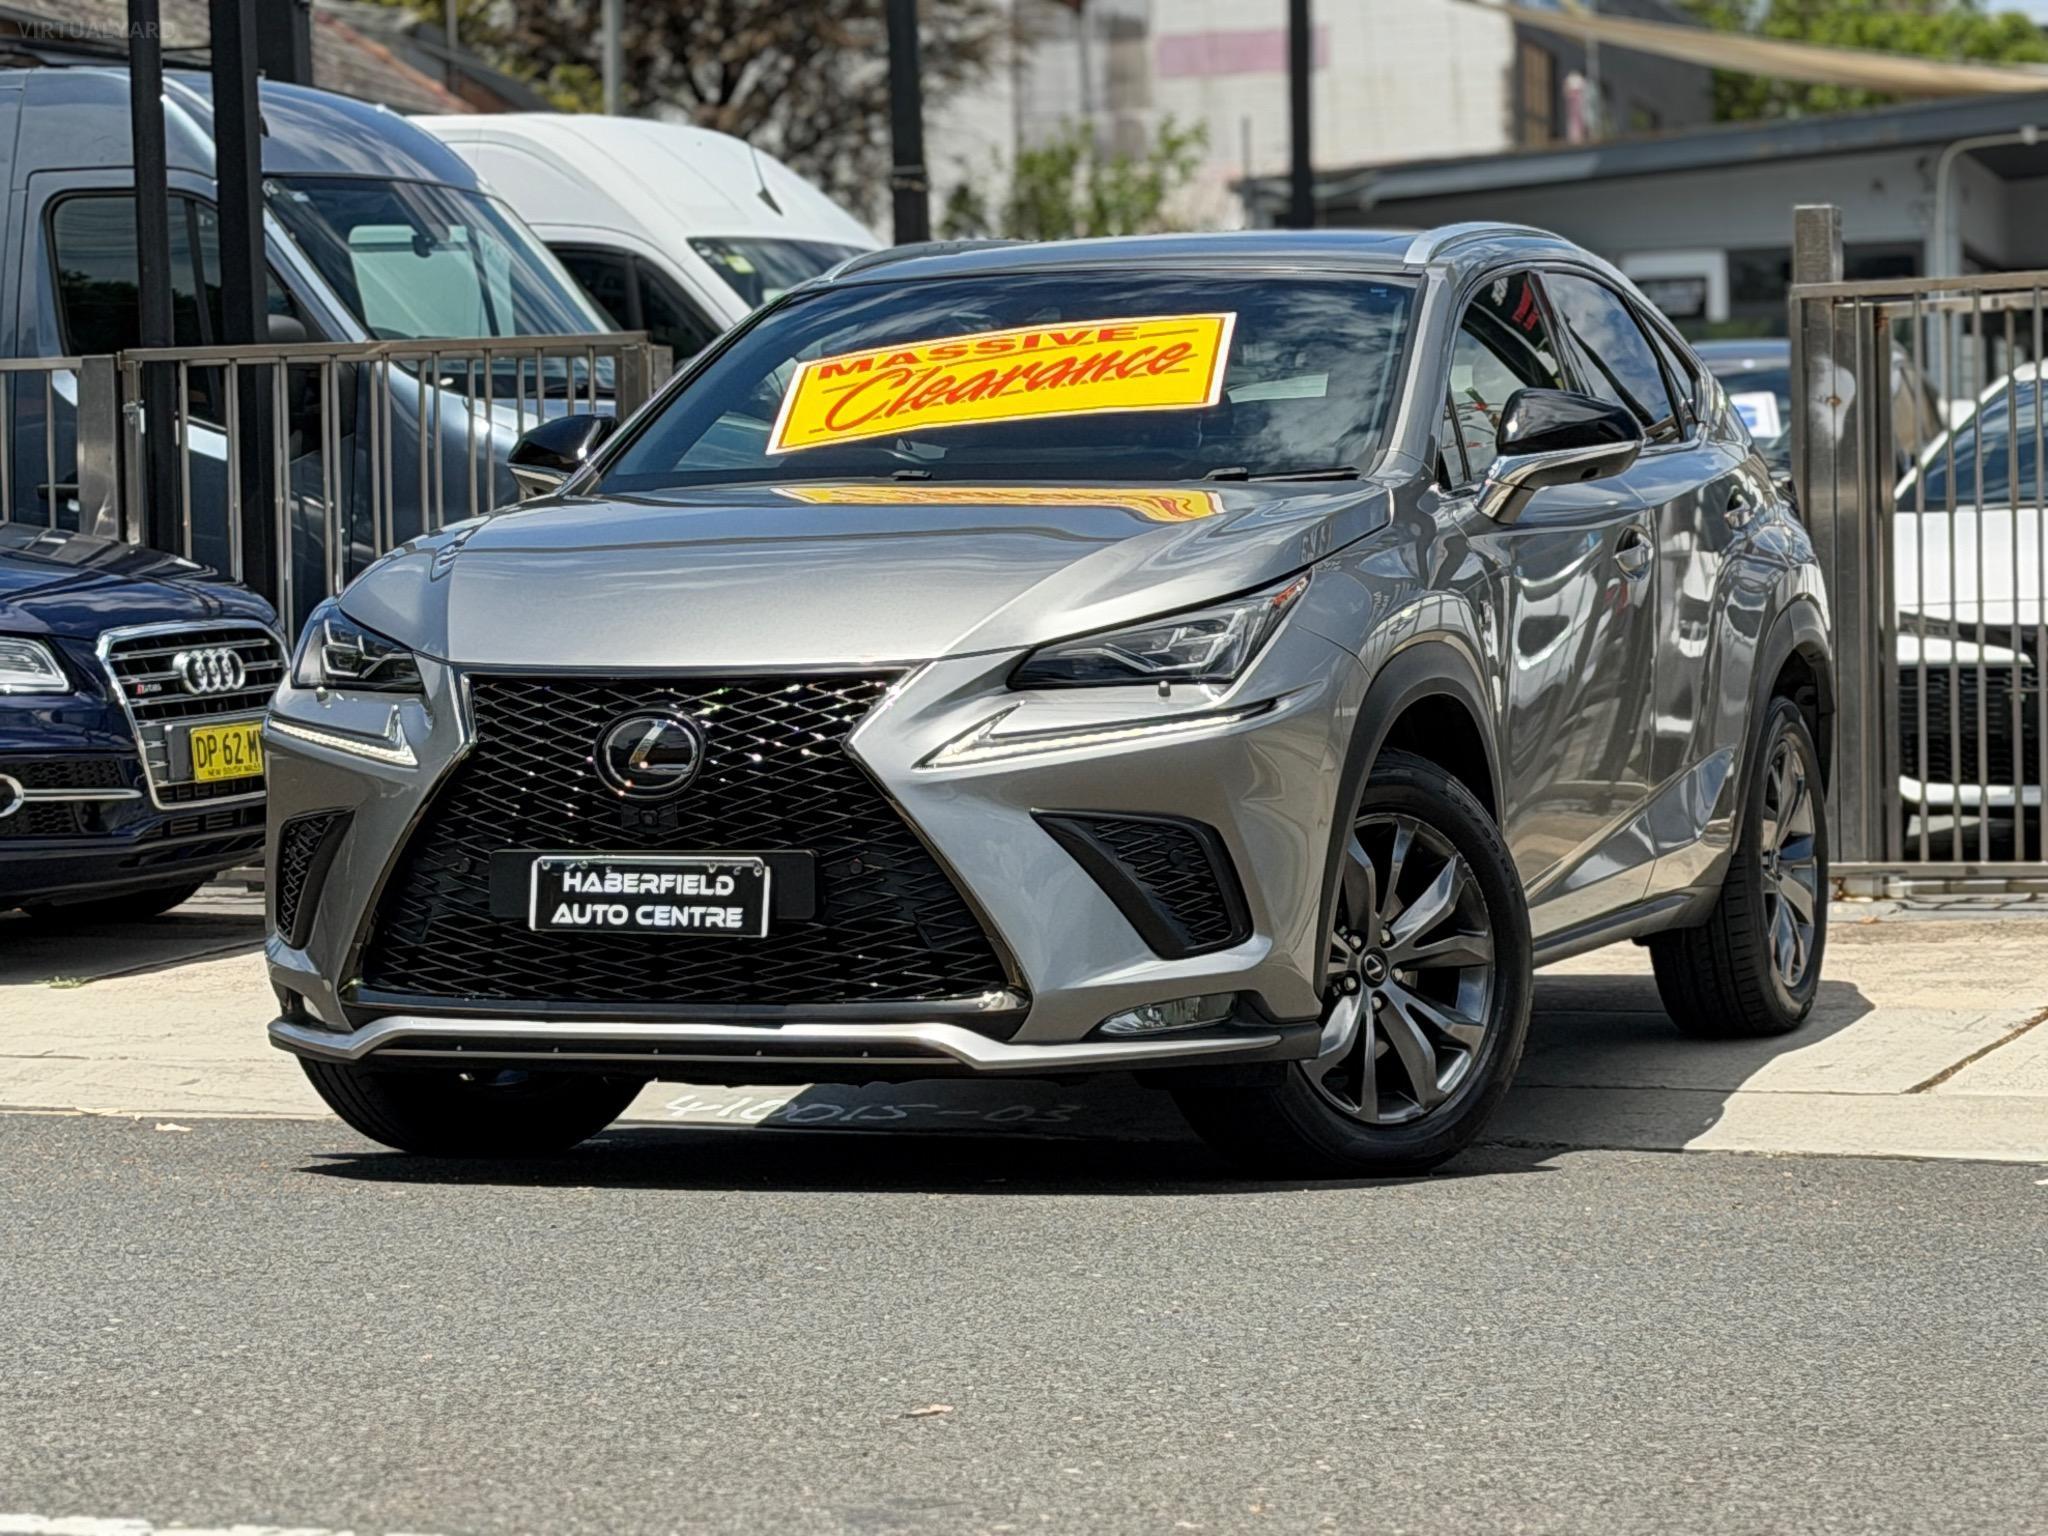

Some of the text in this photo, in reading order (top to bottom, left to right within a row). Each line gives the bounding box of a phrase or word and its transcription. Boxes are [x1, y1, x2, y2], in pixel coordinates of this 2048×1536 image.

[817, 326, 1139, 380] MASSIVE
[824, 340, 1193, 432] Clearance
[195, 734, 217, 769] DP
[222, 732, 244, 765] 62
[562, 871, 735, 896] HABERFIELD
[550, 902, 744, 928] AUTO CENTRE
